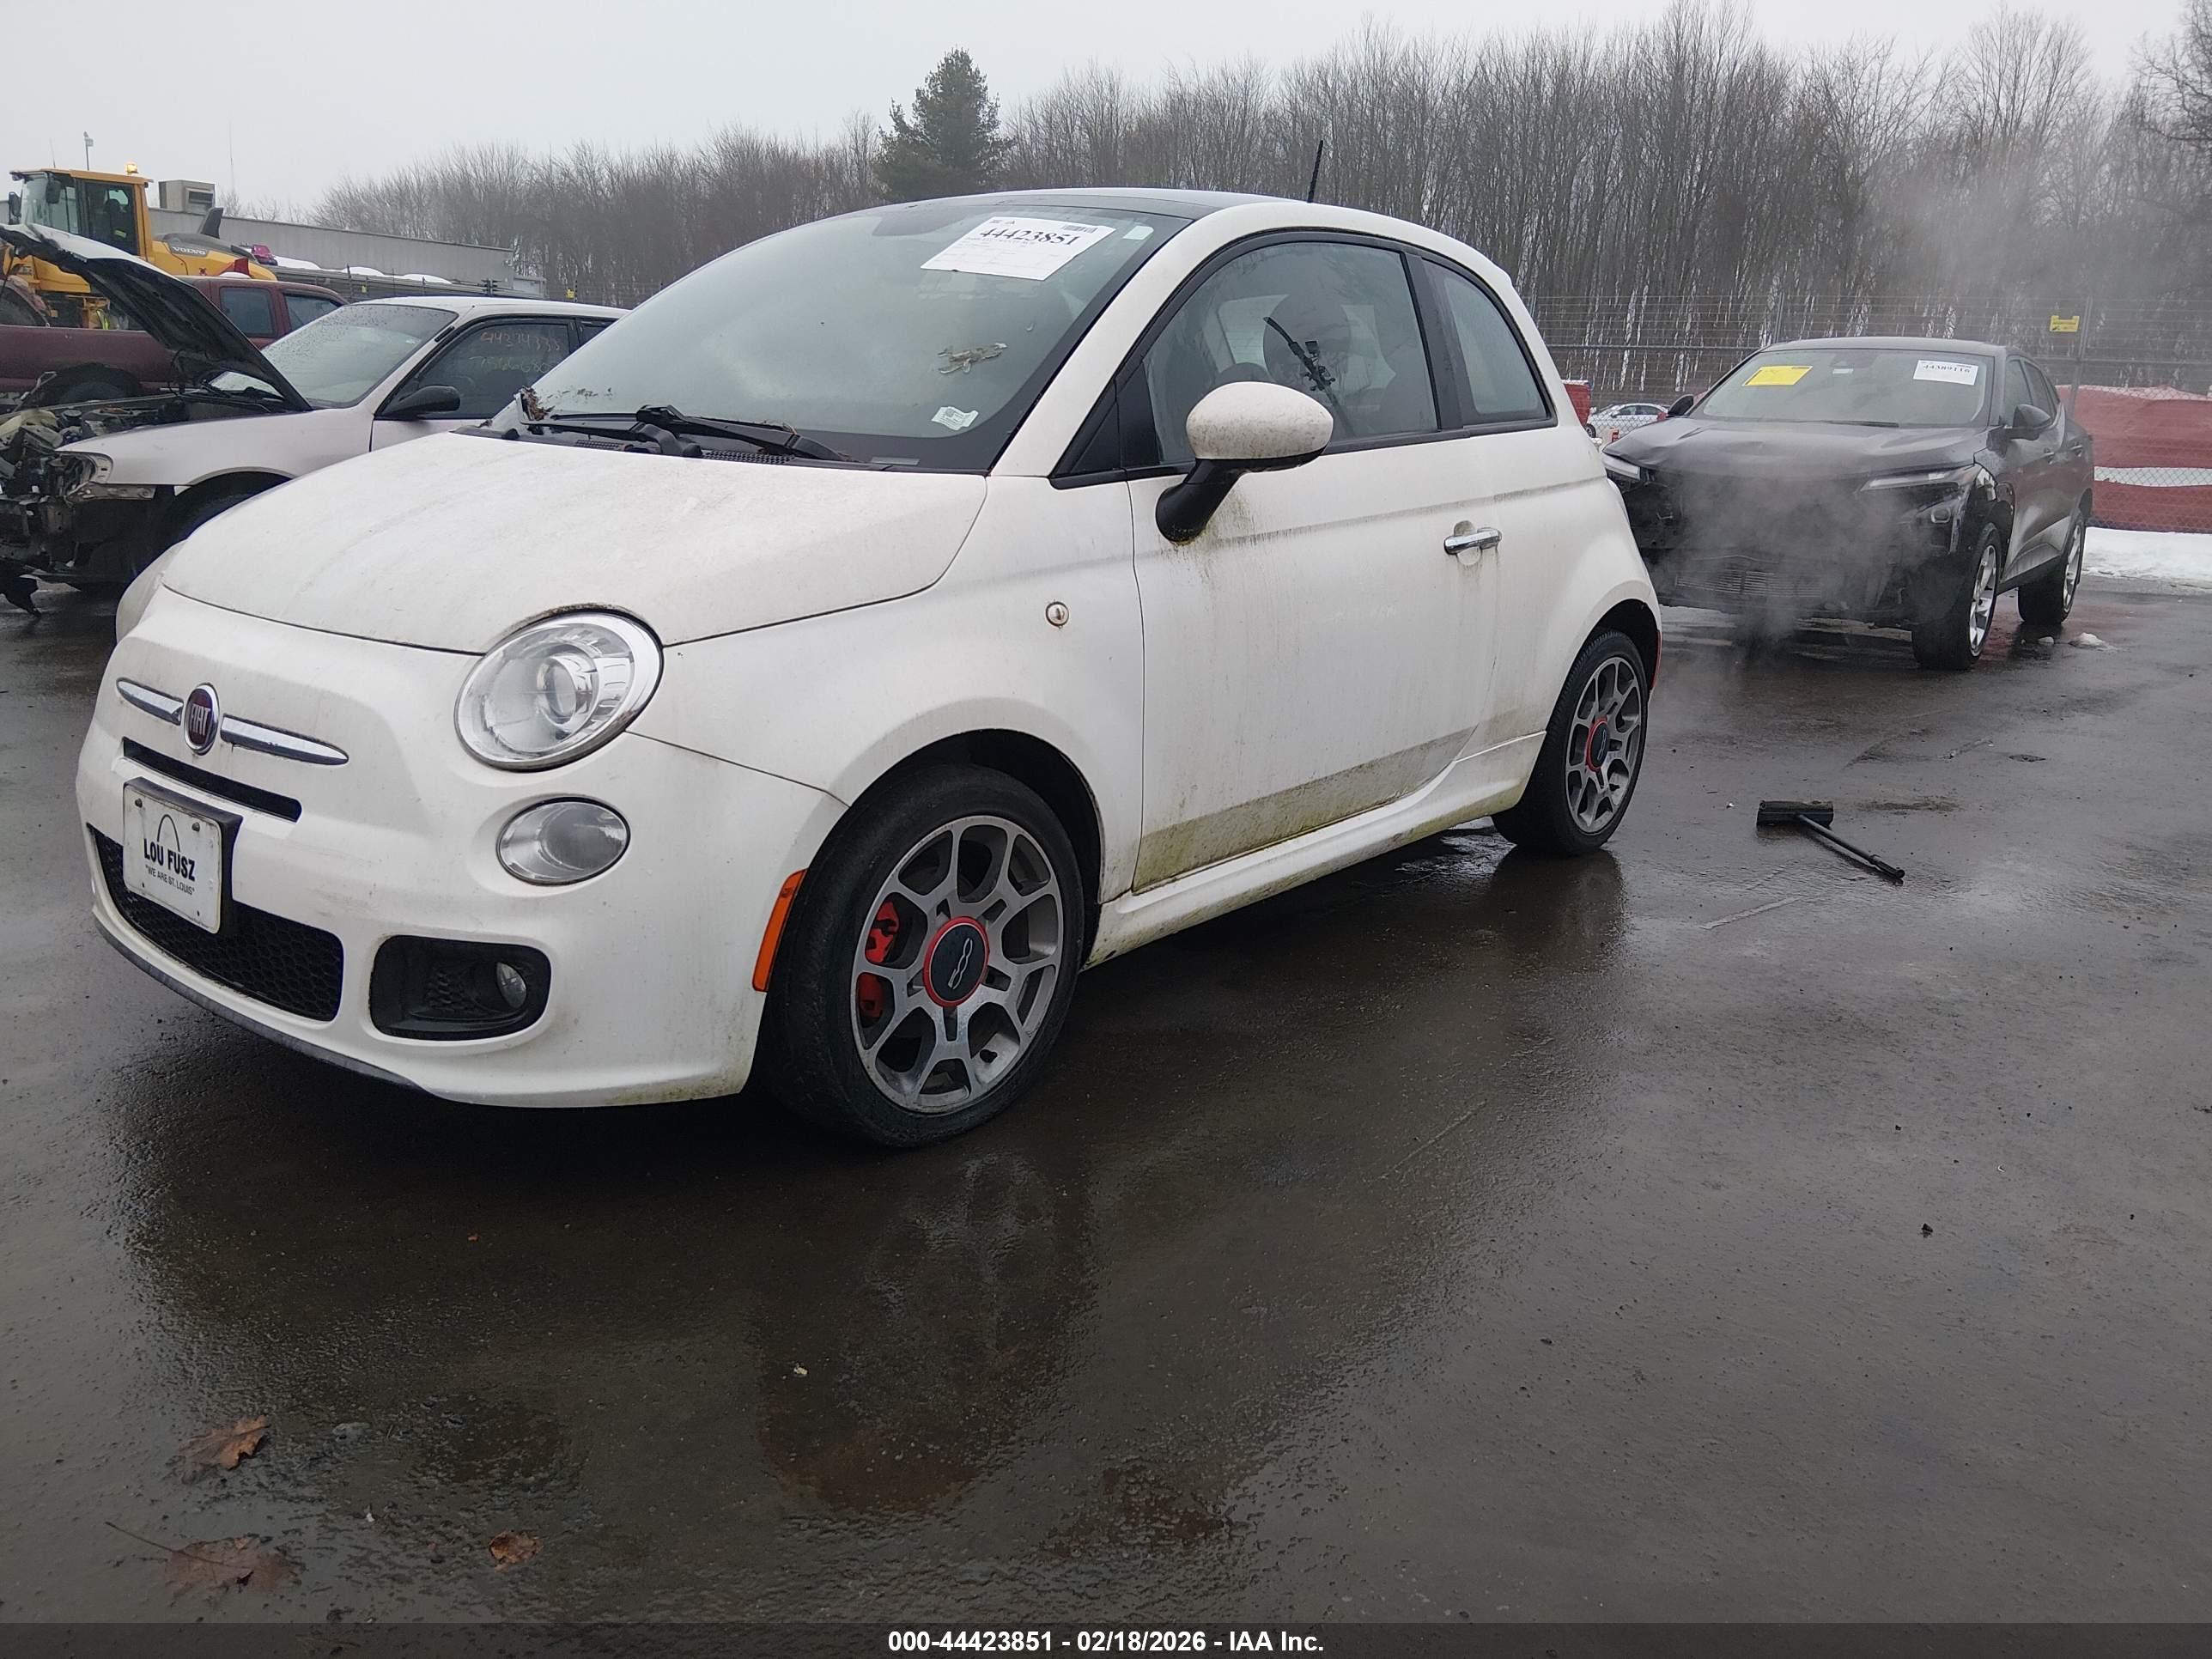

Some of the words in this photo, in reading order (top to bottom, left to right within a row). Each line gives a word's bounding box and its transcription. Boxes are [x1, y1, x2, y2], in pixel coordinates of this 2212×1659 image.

[979, 227, 1080, 246] 44423851
[172, 246, 206, 255] VOLVO
[189, 702, 211, 738] FIAT
[143, 838, 164, 866] LOU
[167, 848, 196, 882] FUSZ
[156, 872, 167, 884] ARE
